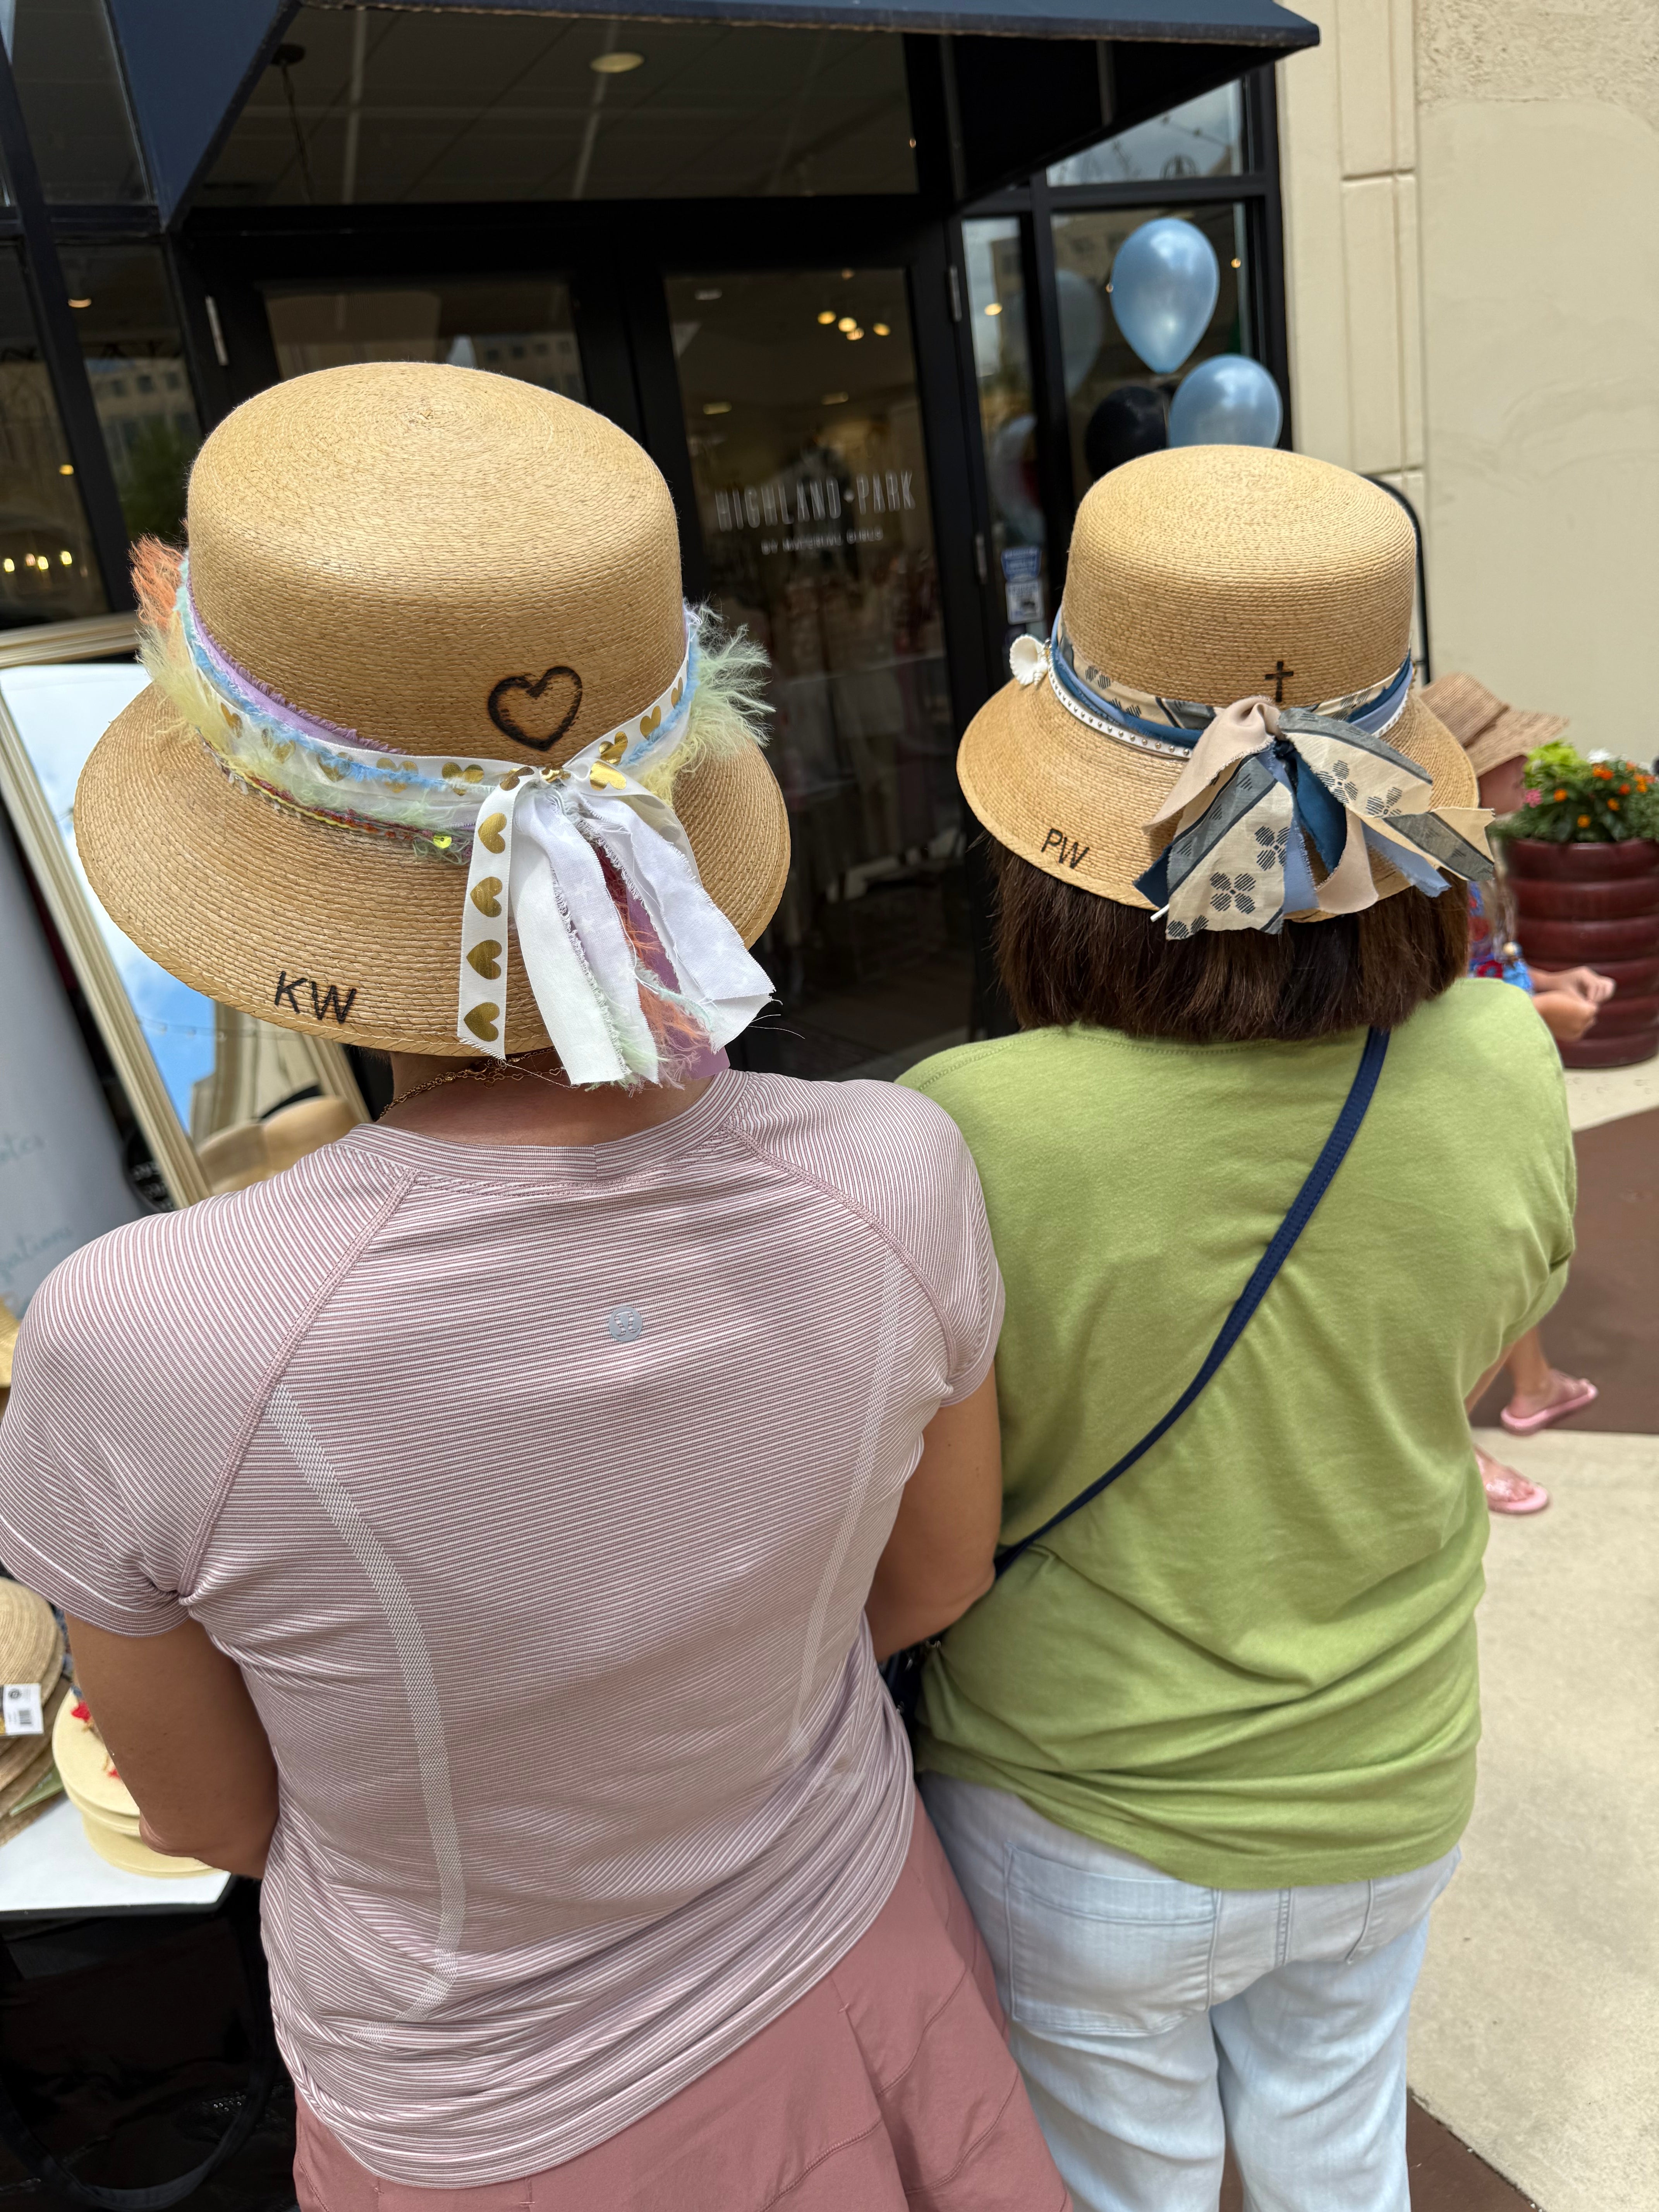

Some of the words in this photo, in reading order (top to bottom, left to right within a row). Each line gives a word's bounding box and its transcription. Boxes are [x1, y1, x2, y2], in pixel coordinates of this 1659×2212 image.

[715, 476, 841, 532] HIGHLAND
[856, 469, 916, 515] PARK
[1041, 828, 1090, 869] PW
[274, 970, 357, 1024] KW
